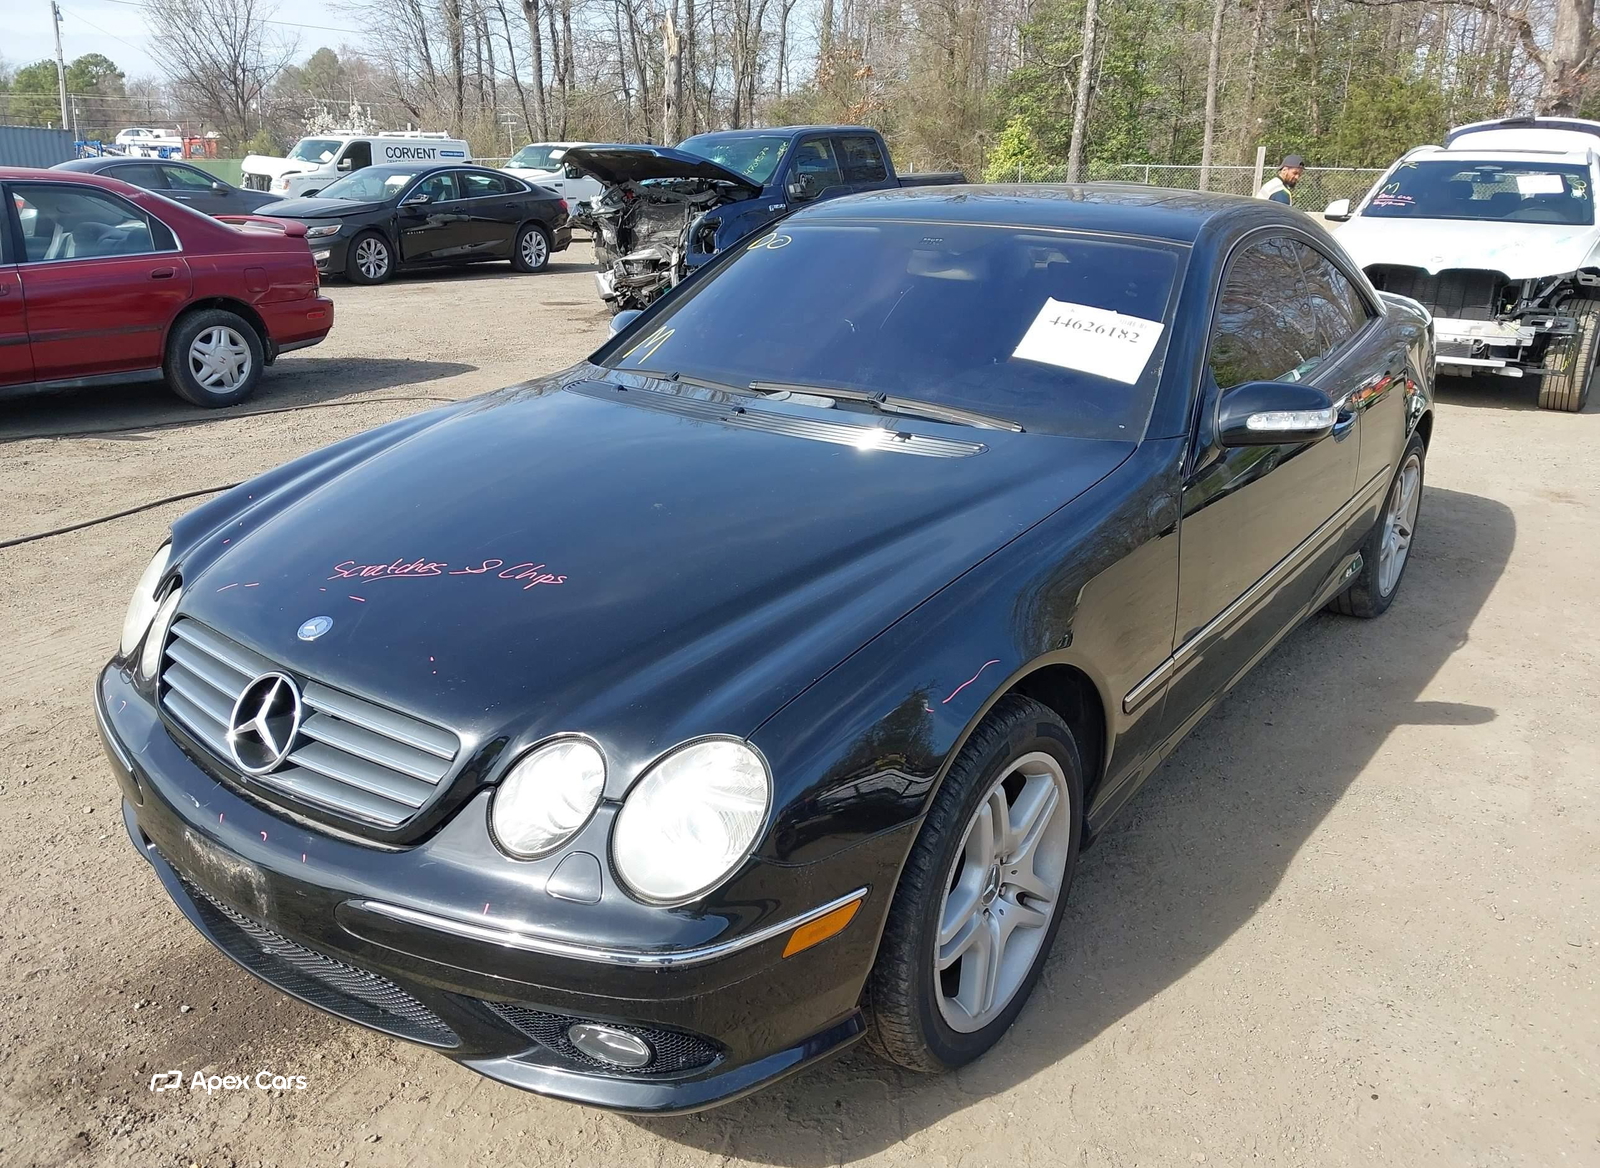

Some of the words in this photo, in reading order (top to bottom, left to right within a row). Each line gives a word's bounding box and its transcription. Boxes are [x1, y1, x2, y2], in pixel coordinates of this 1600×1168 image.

[385, 146, 437, 160] CORVENT
[1049, 315, 1140, 344] 44626182
[498, 562, 567, 590] Chips
